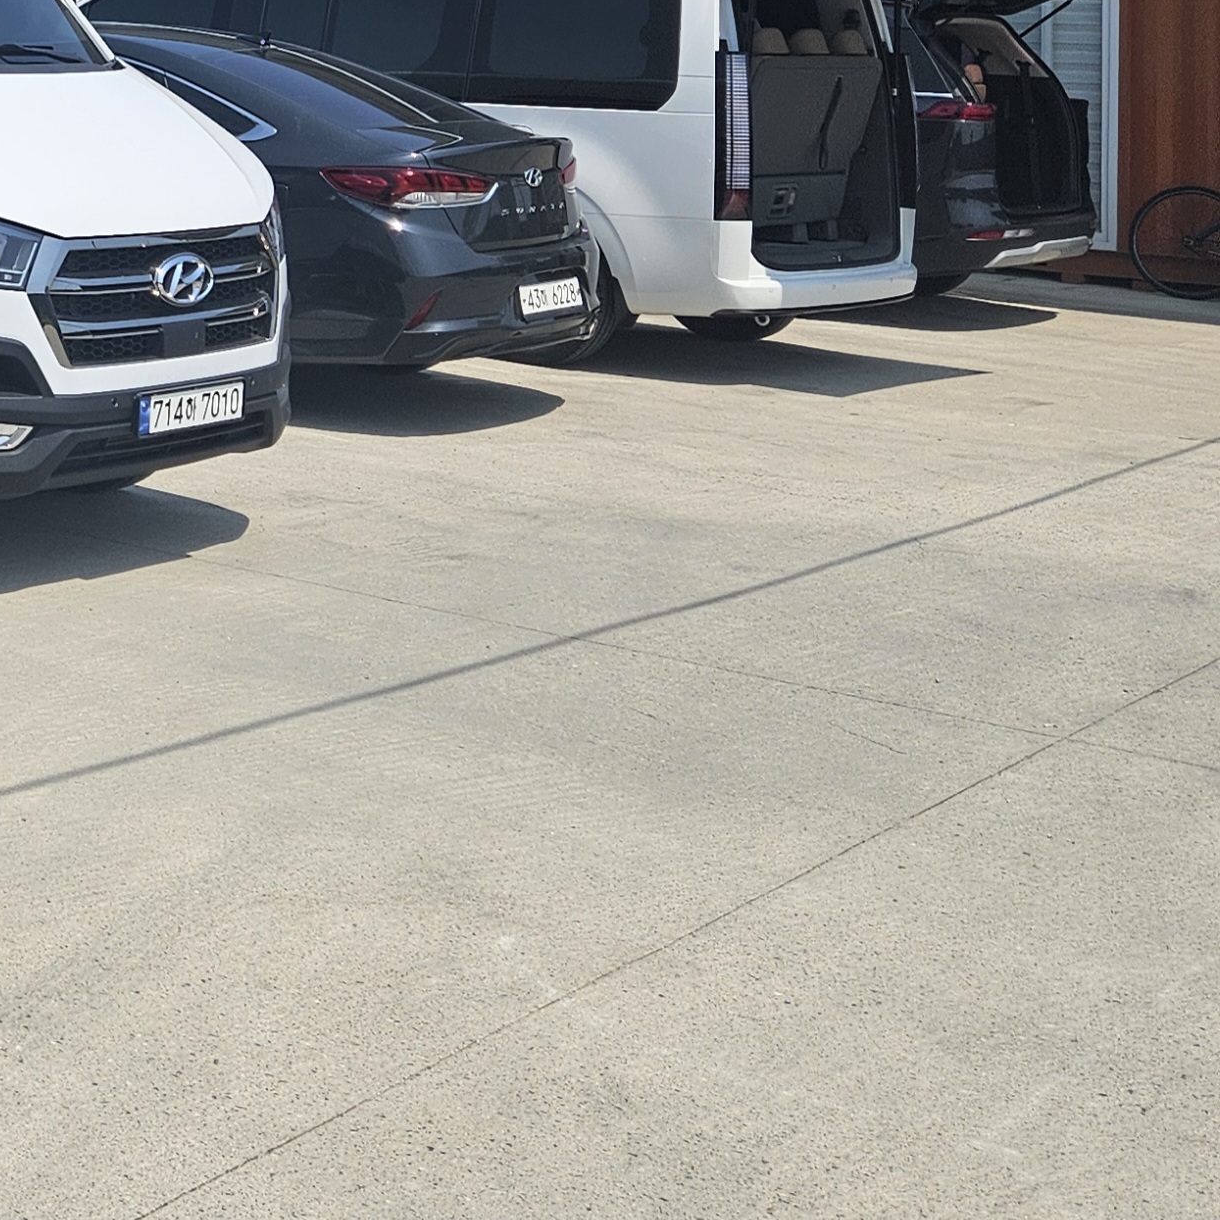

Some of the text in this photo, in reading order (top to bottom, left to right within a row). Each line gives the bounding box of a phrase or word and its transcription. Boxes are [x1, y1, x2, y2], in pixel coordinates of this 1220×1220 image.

[552, 283, 577, 306] 6228
[153, 388, 240, 428] 714하 7010
